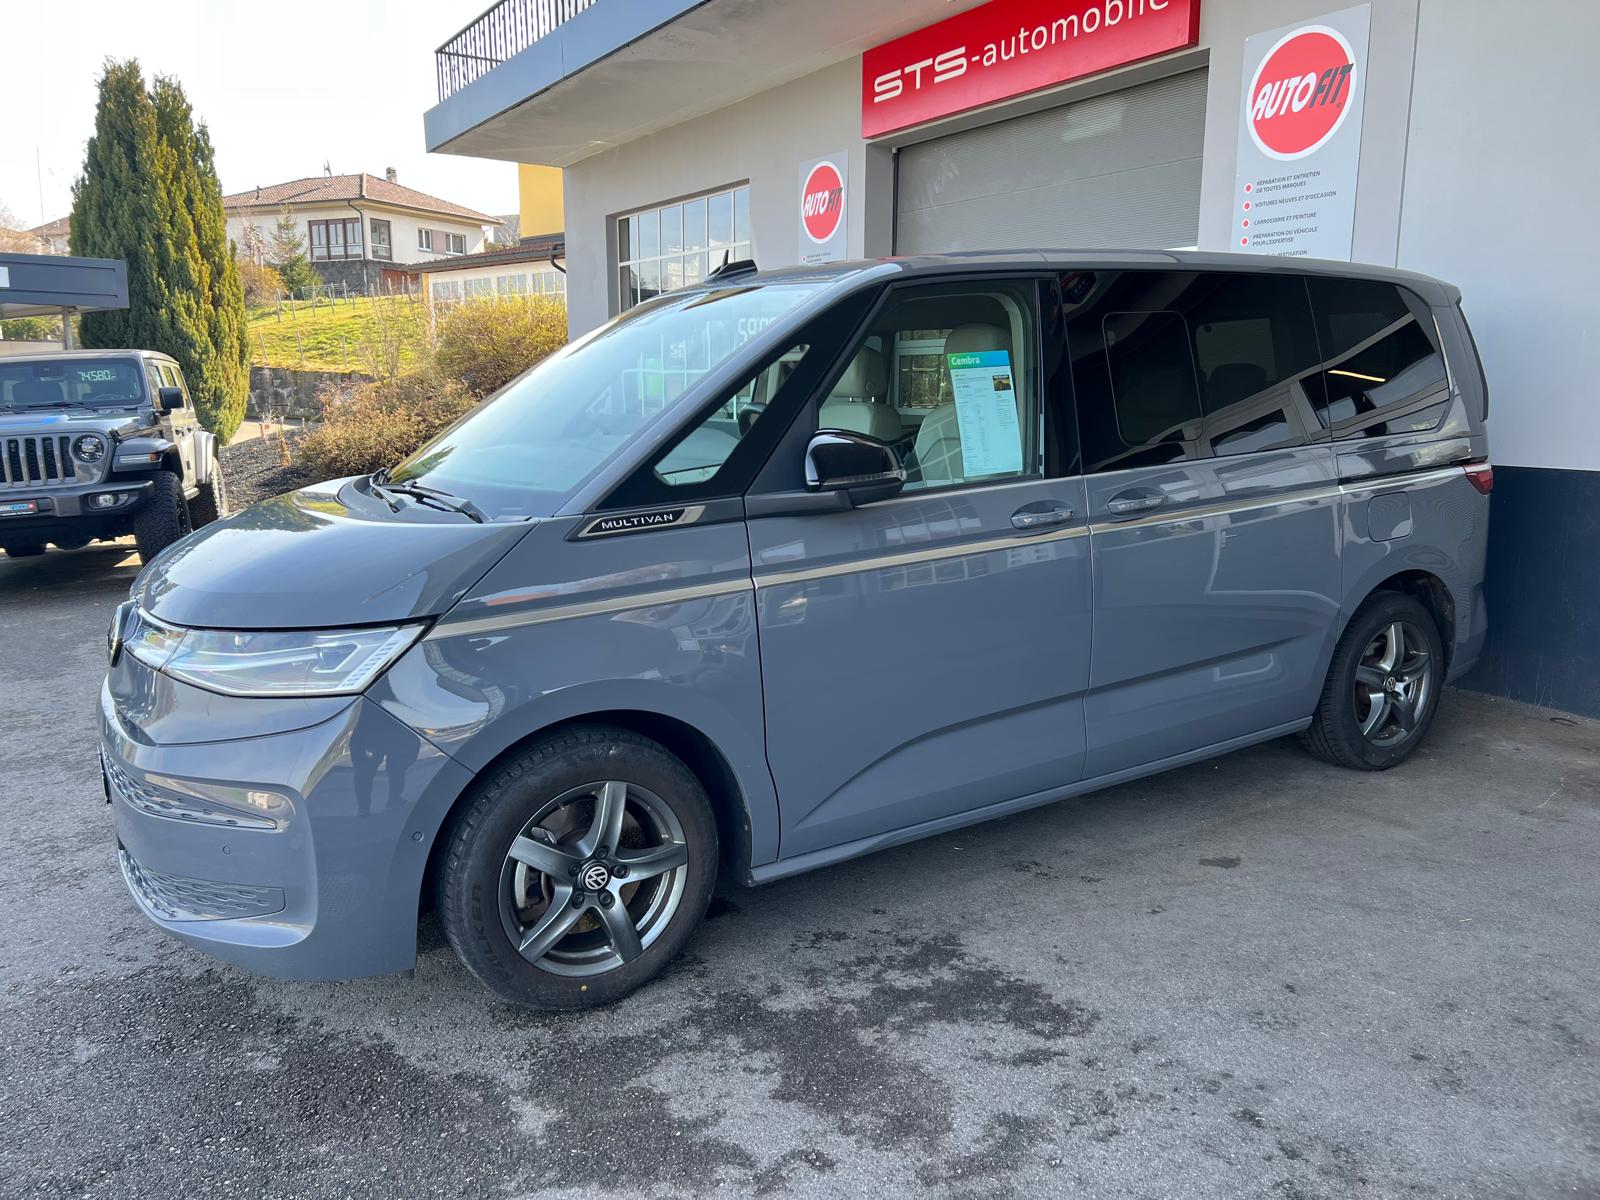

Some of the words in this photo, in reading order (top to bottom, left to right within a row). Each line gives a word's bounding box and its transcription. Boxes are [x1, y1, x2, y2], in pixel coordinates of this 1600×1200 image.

[1252, 62, 1355, 121] AUTOFIT
[1293, 171, 1320, 180] ENTRETIEN
[1305, 190, 1337, 200] D'OCCASION
[804, 187, 843, 218] AUTOFIT
[1254, 216, 1285, 225] CARROSSERIE
[951, 356, 981, 366] Cembra
[601, 513, 674, 530] MULTIVAN
